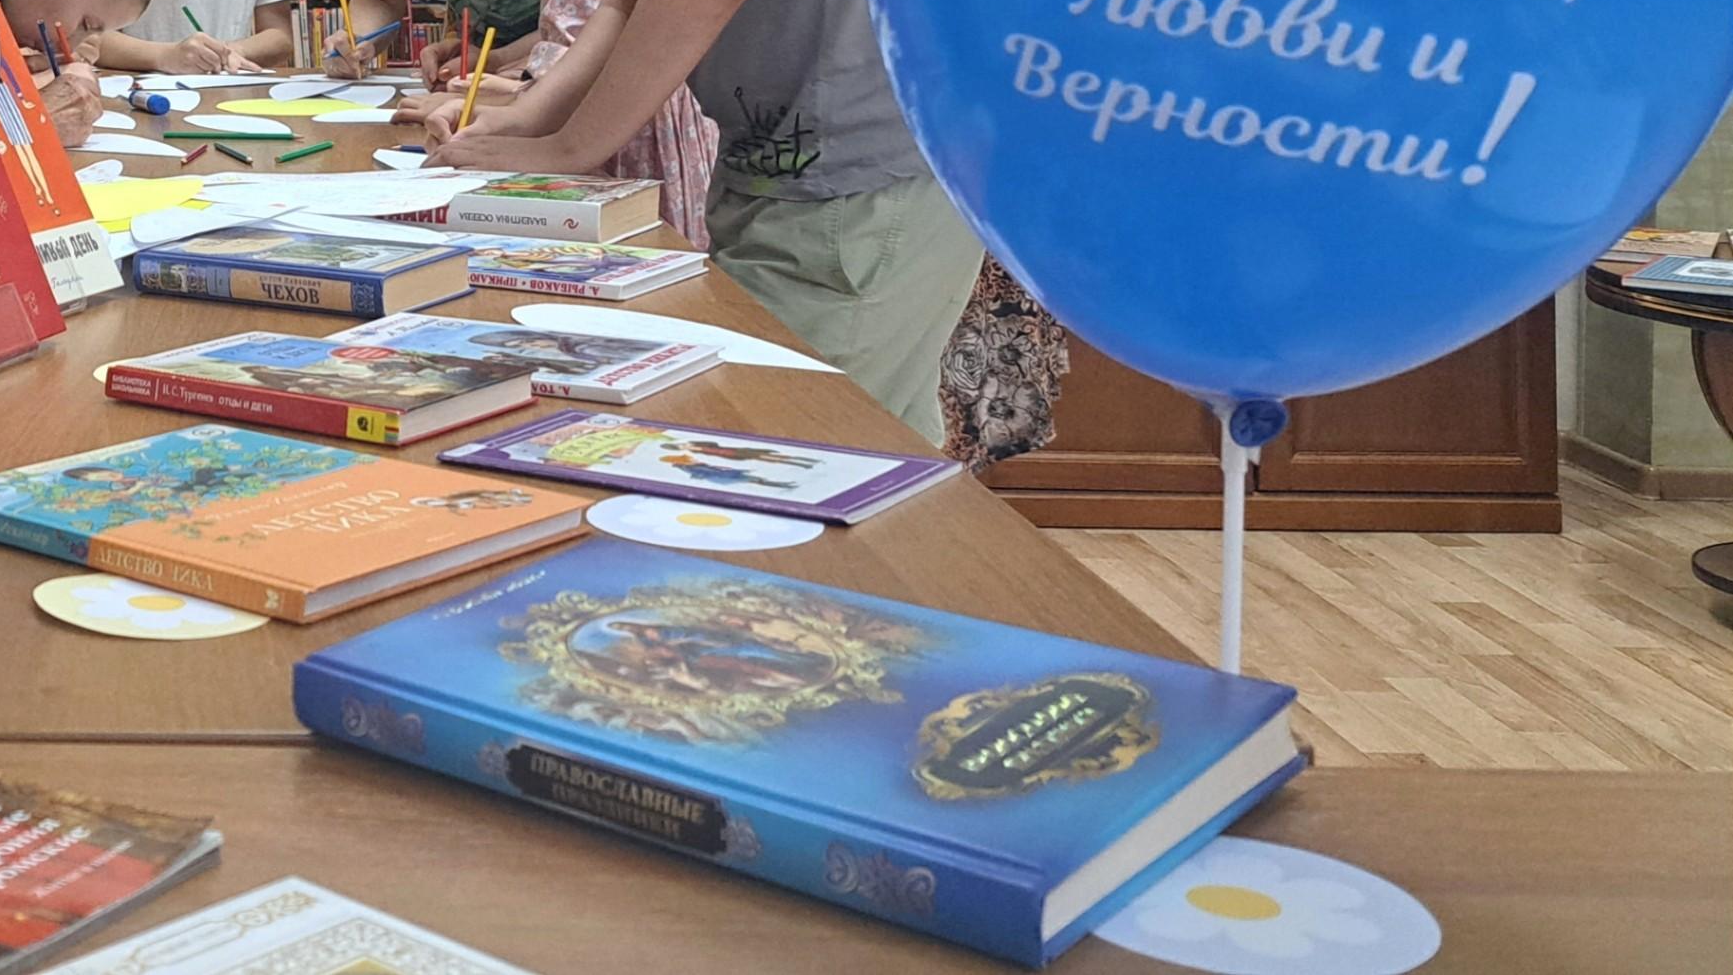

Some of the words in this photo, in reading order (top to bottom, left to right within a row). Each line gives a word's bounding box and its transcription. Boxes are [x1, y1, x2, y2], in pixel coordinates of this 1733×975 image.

[1409, 33, 1469, 85] и
[1004, 33, 1536, 187] Верности!
[458, 211, 494, 224] ОСЕЕВА
[495, 213, 548, 227] ВАЛЕНТИНА
[72, 232, 99, 258] ДЕНЬ
[468, 272, 518, 288] ПРИКЛЮ
[529, 280, 586, 295] РЫБАКОВ
[589, 285, 600, 297] А.
[261, 282, 320, 306] ЧЕХОВ
[111, 384, 150, 396] ШКОЛЬНИКА
[112, 376, 151, 388] БИБЛИОТЕКА
[180, 386, 213, 403] Тургенев
[218, 397, 241, 408] ОТЦЫ
[251, 403, 273, 412] ДЕТИ
[254, 488, 402, 537] ДЕТСТВО
[95, 544, 163, 578] ДЕТСТВО
[530, 752, 704, 824] ПРАВОСЛАВНЫЕ
